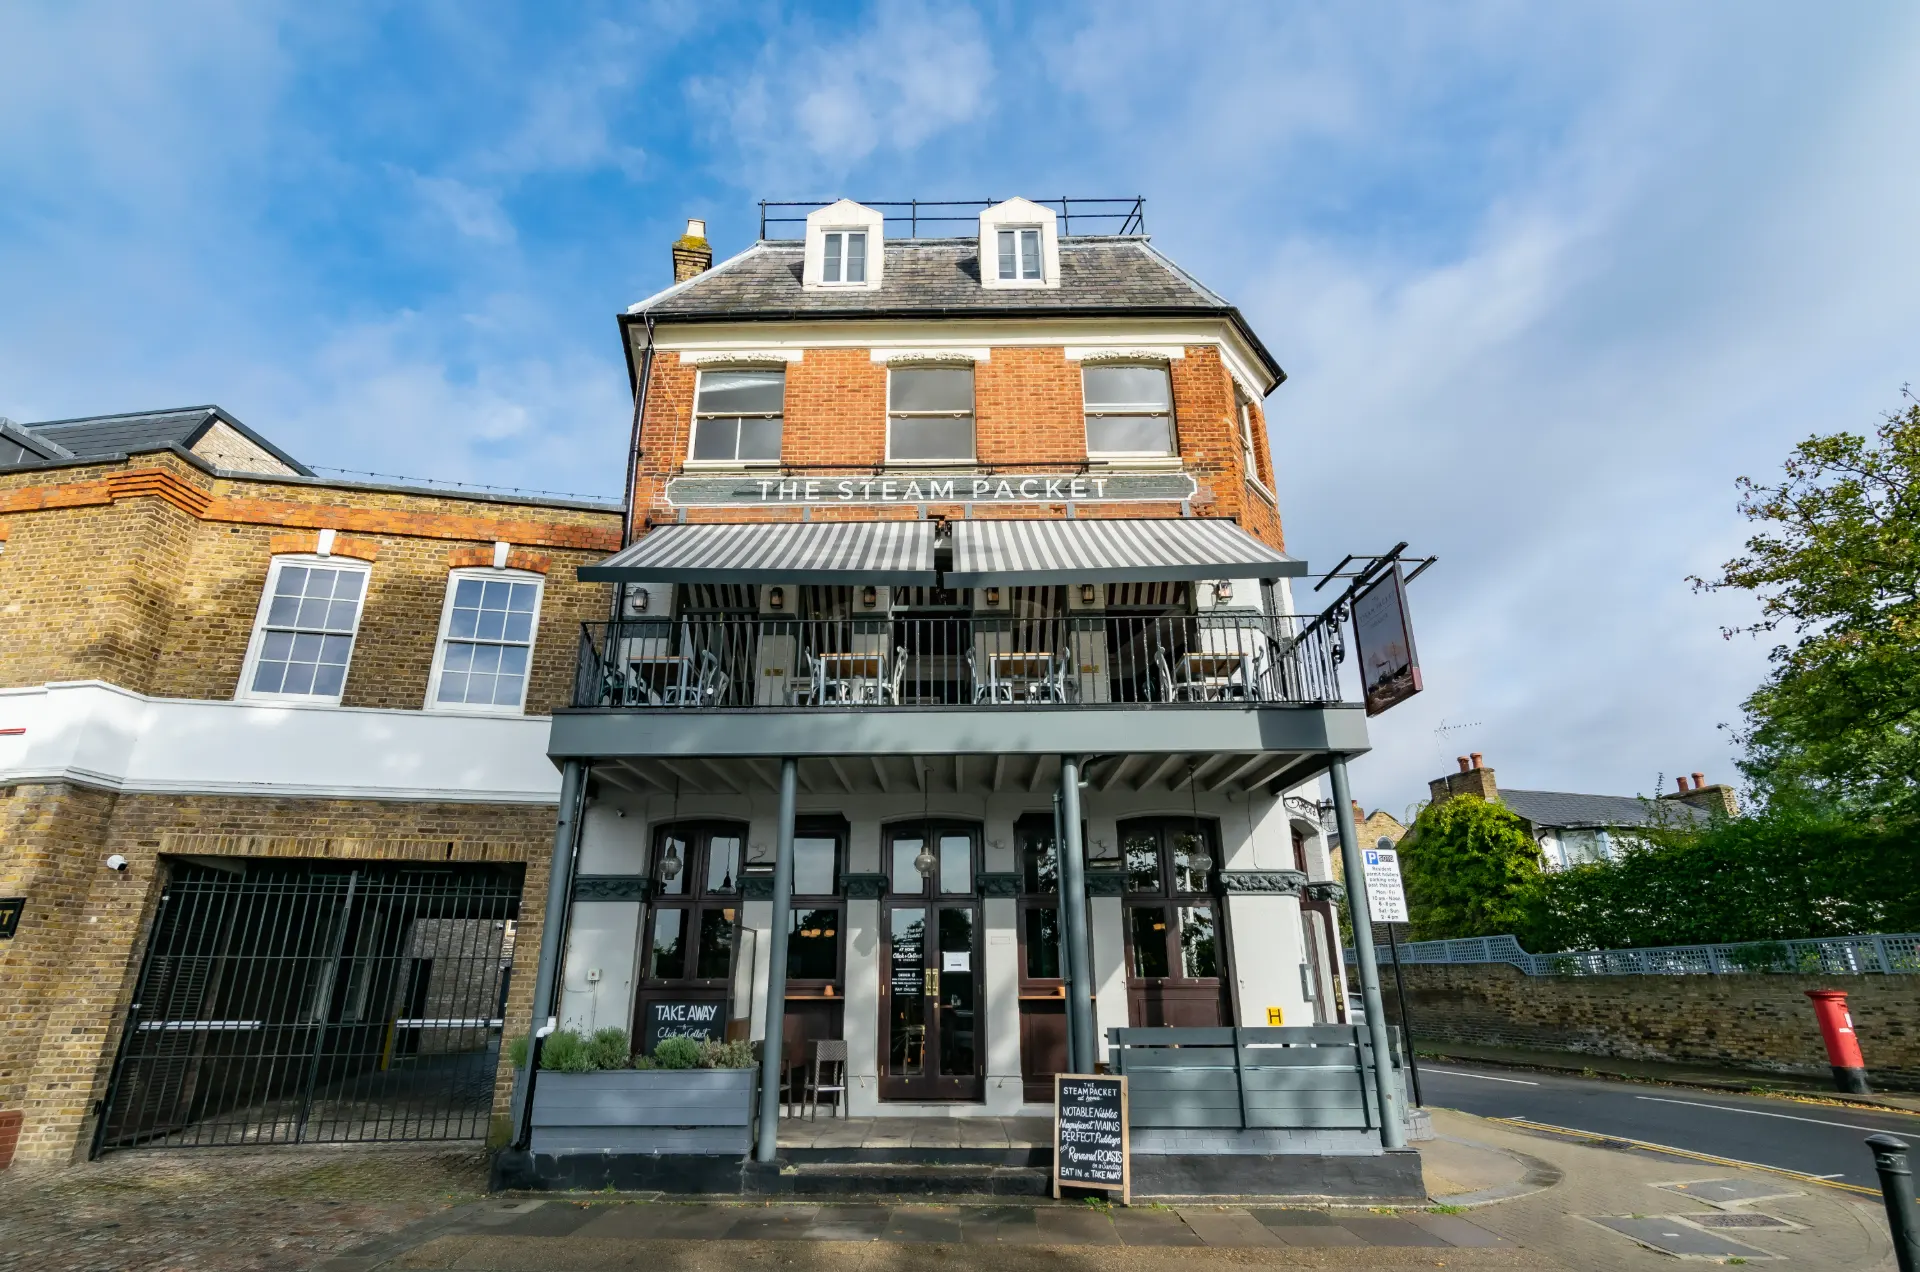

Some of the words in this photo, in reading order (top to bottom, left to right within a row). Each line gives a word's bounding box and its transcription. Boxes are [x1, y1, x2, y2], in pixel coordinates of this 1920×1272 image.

[757, 481, 821, 500] THE
[837, 479, 954, 500] STEAM
[972, 477, 1108, 499] PACKET
[656, 1005, 686, 1020] TAKE
[686, 1005, 718, 1020] AWAY
[1268, 1008, 1282, 1024] H
[657, 1027, 678, 1038] Click
[687, 1028, 711, 1038] Collect
[1063, 1087, 1088, 1096] STEAM
[1089, 1088, 1117, 1096] PACKET
[1062, 1106, 1093, 1117] NOTABLE
[1094, 1107, 1118, 1118] Nibbles
[1059, 1118, 1095, 1131] Magnificent
[1094, 1120, 1120, 1131] MAINS
[1062, 1131, 1095, 1142] PERFECT
[1094, 1132, 1120, 1147] Puddings
[1069, 1146, 1098, 1162] Renowned
[1098, 1150, 1122, 1163] ROASTS
[1061, 1167, 1074, 1176] EAT
[1075, 1169, 1082, 1177] IN
[1091, 1170, 1106, 1179] TAKE
[1107, 1171, 1121, 1180] AWAY
[1102, 1162, 1121, 1172] Sunday
